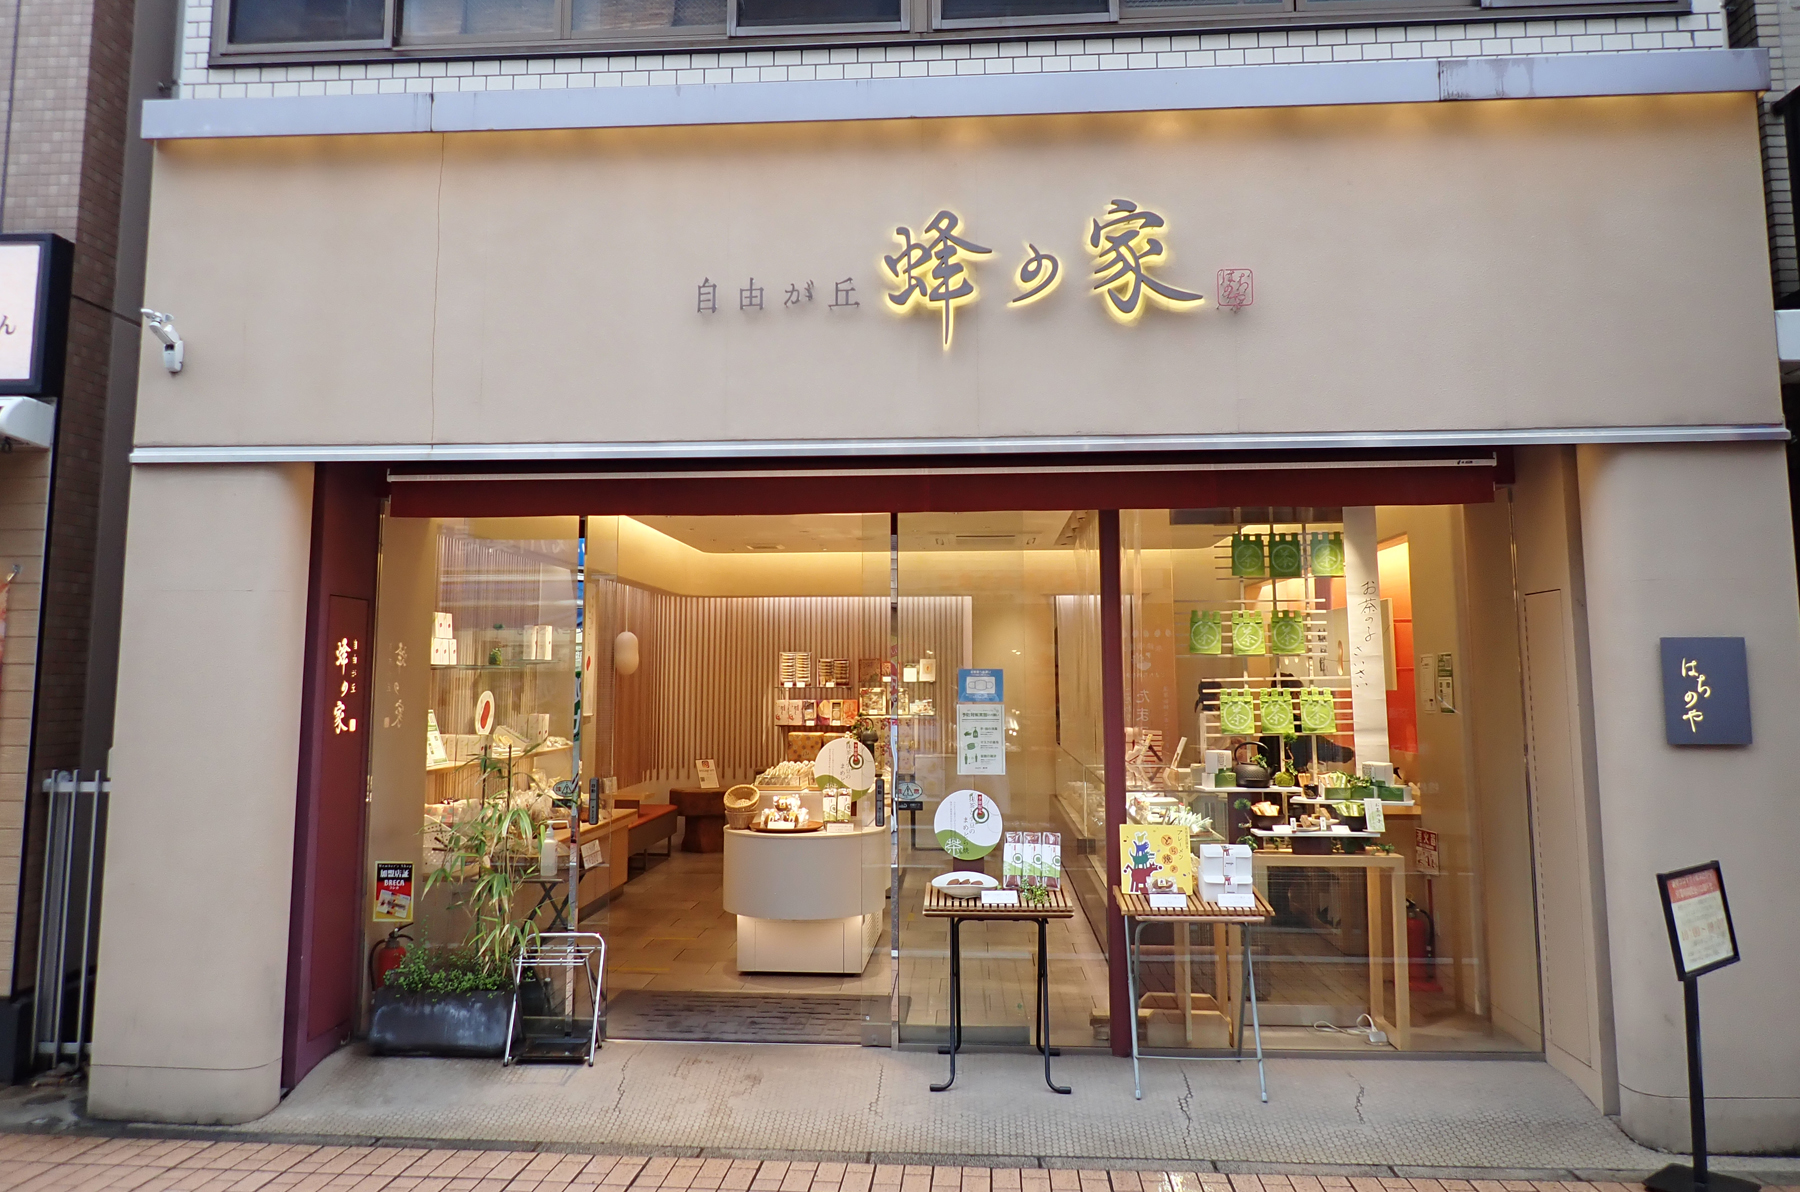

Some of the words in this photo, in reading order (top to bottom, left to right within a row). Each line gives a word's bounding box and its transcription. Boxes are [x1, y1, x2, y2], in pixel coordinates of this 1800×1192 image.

[697, 277, 860, 313] 自由が丘
[884, 199, 1203, 344] 蜂の家
[1358, 580, 1378, 641] お茶の子
[333, 637, 351, 735] 蜂の家
[1681, 657, 1712, 733] はちのや
